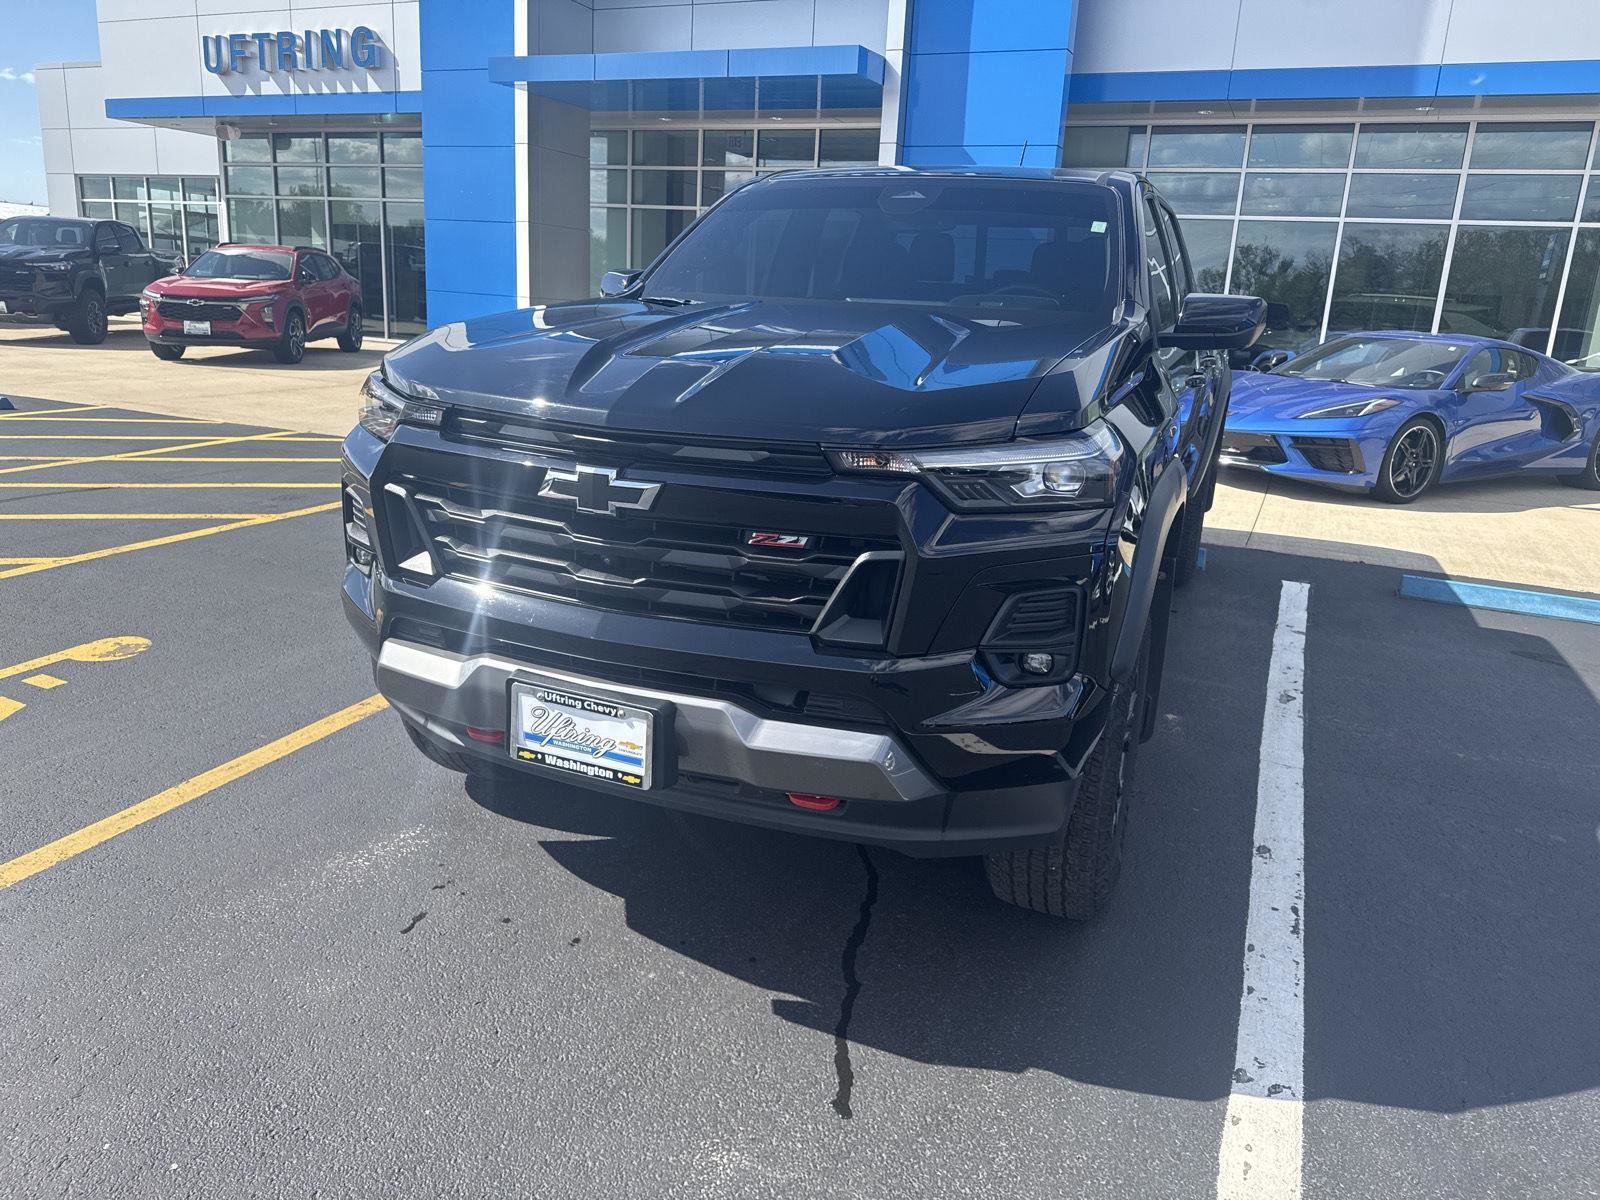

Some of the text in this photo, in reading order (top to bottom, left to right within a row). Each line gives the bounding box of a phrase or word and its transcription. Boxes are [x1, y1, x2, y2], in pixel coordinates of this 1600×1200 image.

[203, 26, 379, 75] UFTRING
[544, 692, 617, 718] Uftring Chevy
[531, 706, 617, 758] Uftring
[552, 739, 592, 753] WASHINGTON
[544, 753, 614, 779] Washington
